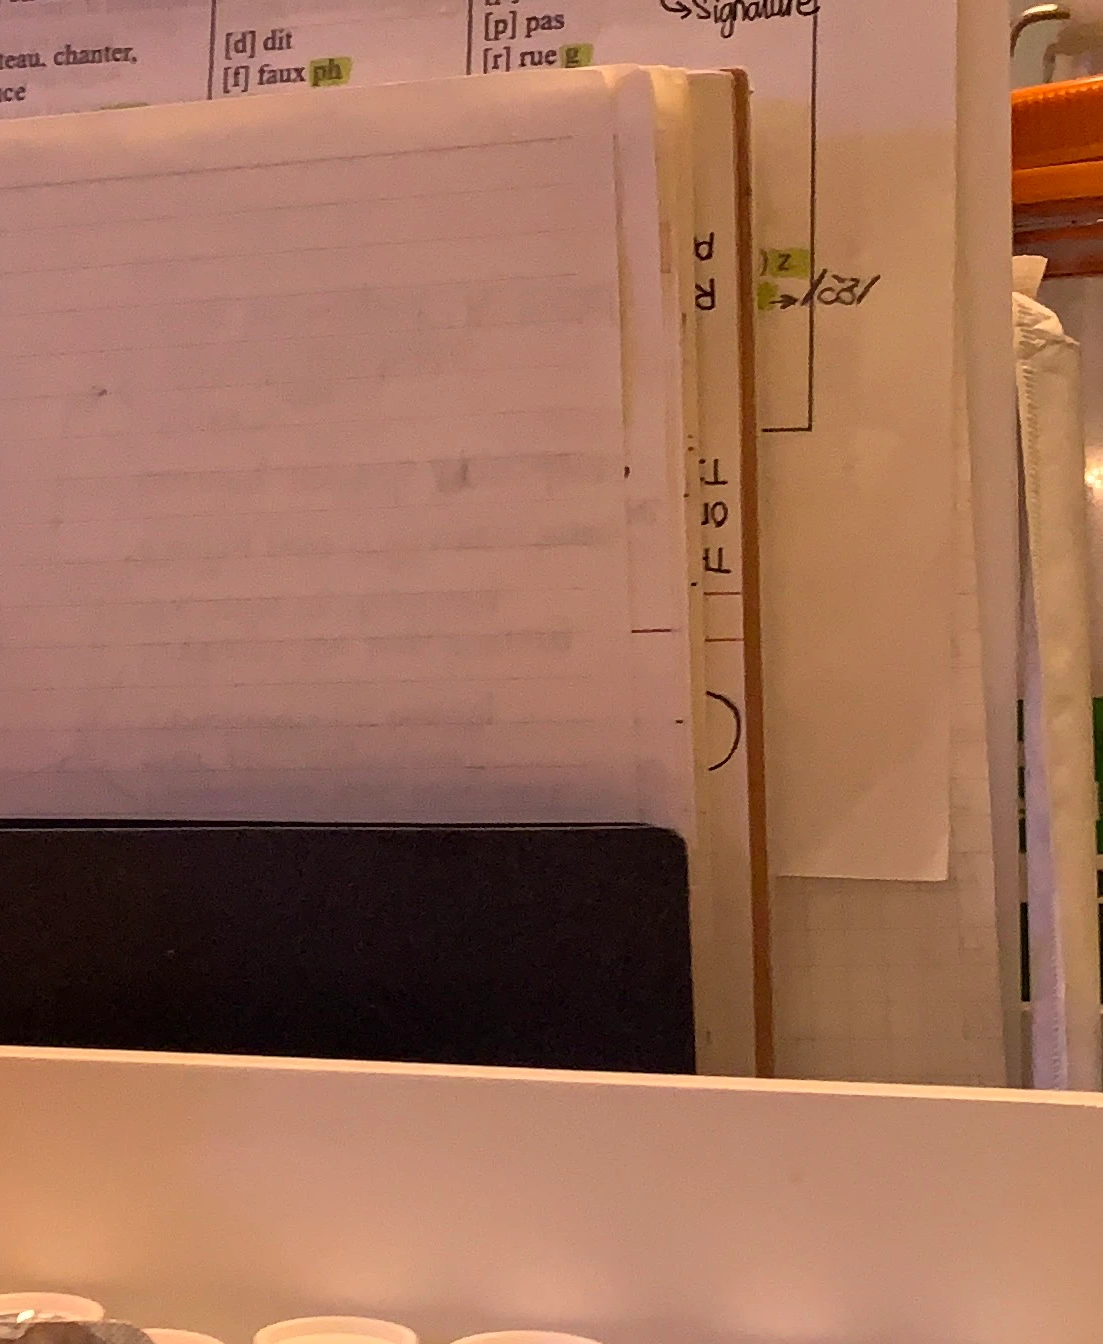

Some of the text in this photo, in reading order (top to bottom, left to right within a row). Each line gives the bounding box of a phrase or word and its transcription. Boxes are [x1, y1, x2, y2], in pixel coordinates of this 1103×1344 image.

[525, 14, 565, 38] pas
[262, 27, 293, 51] dit
[519, 50, 558, 68] rue
[257, 63, 306, 86] faux
[312, 58, 343, 87] ph
